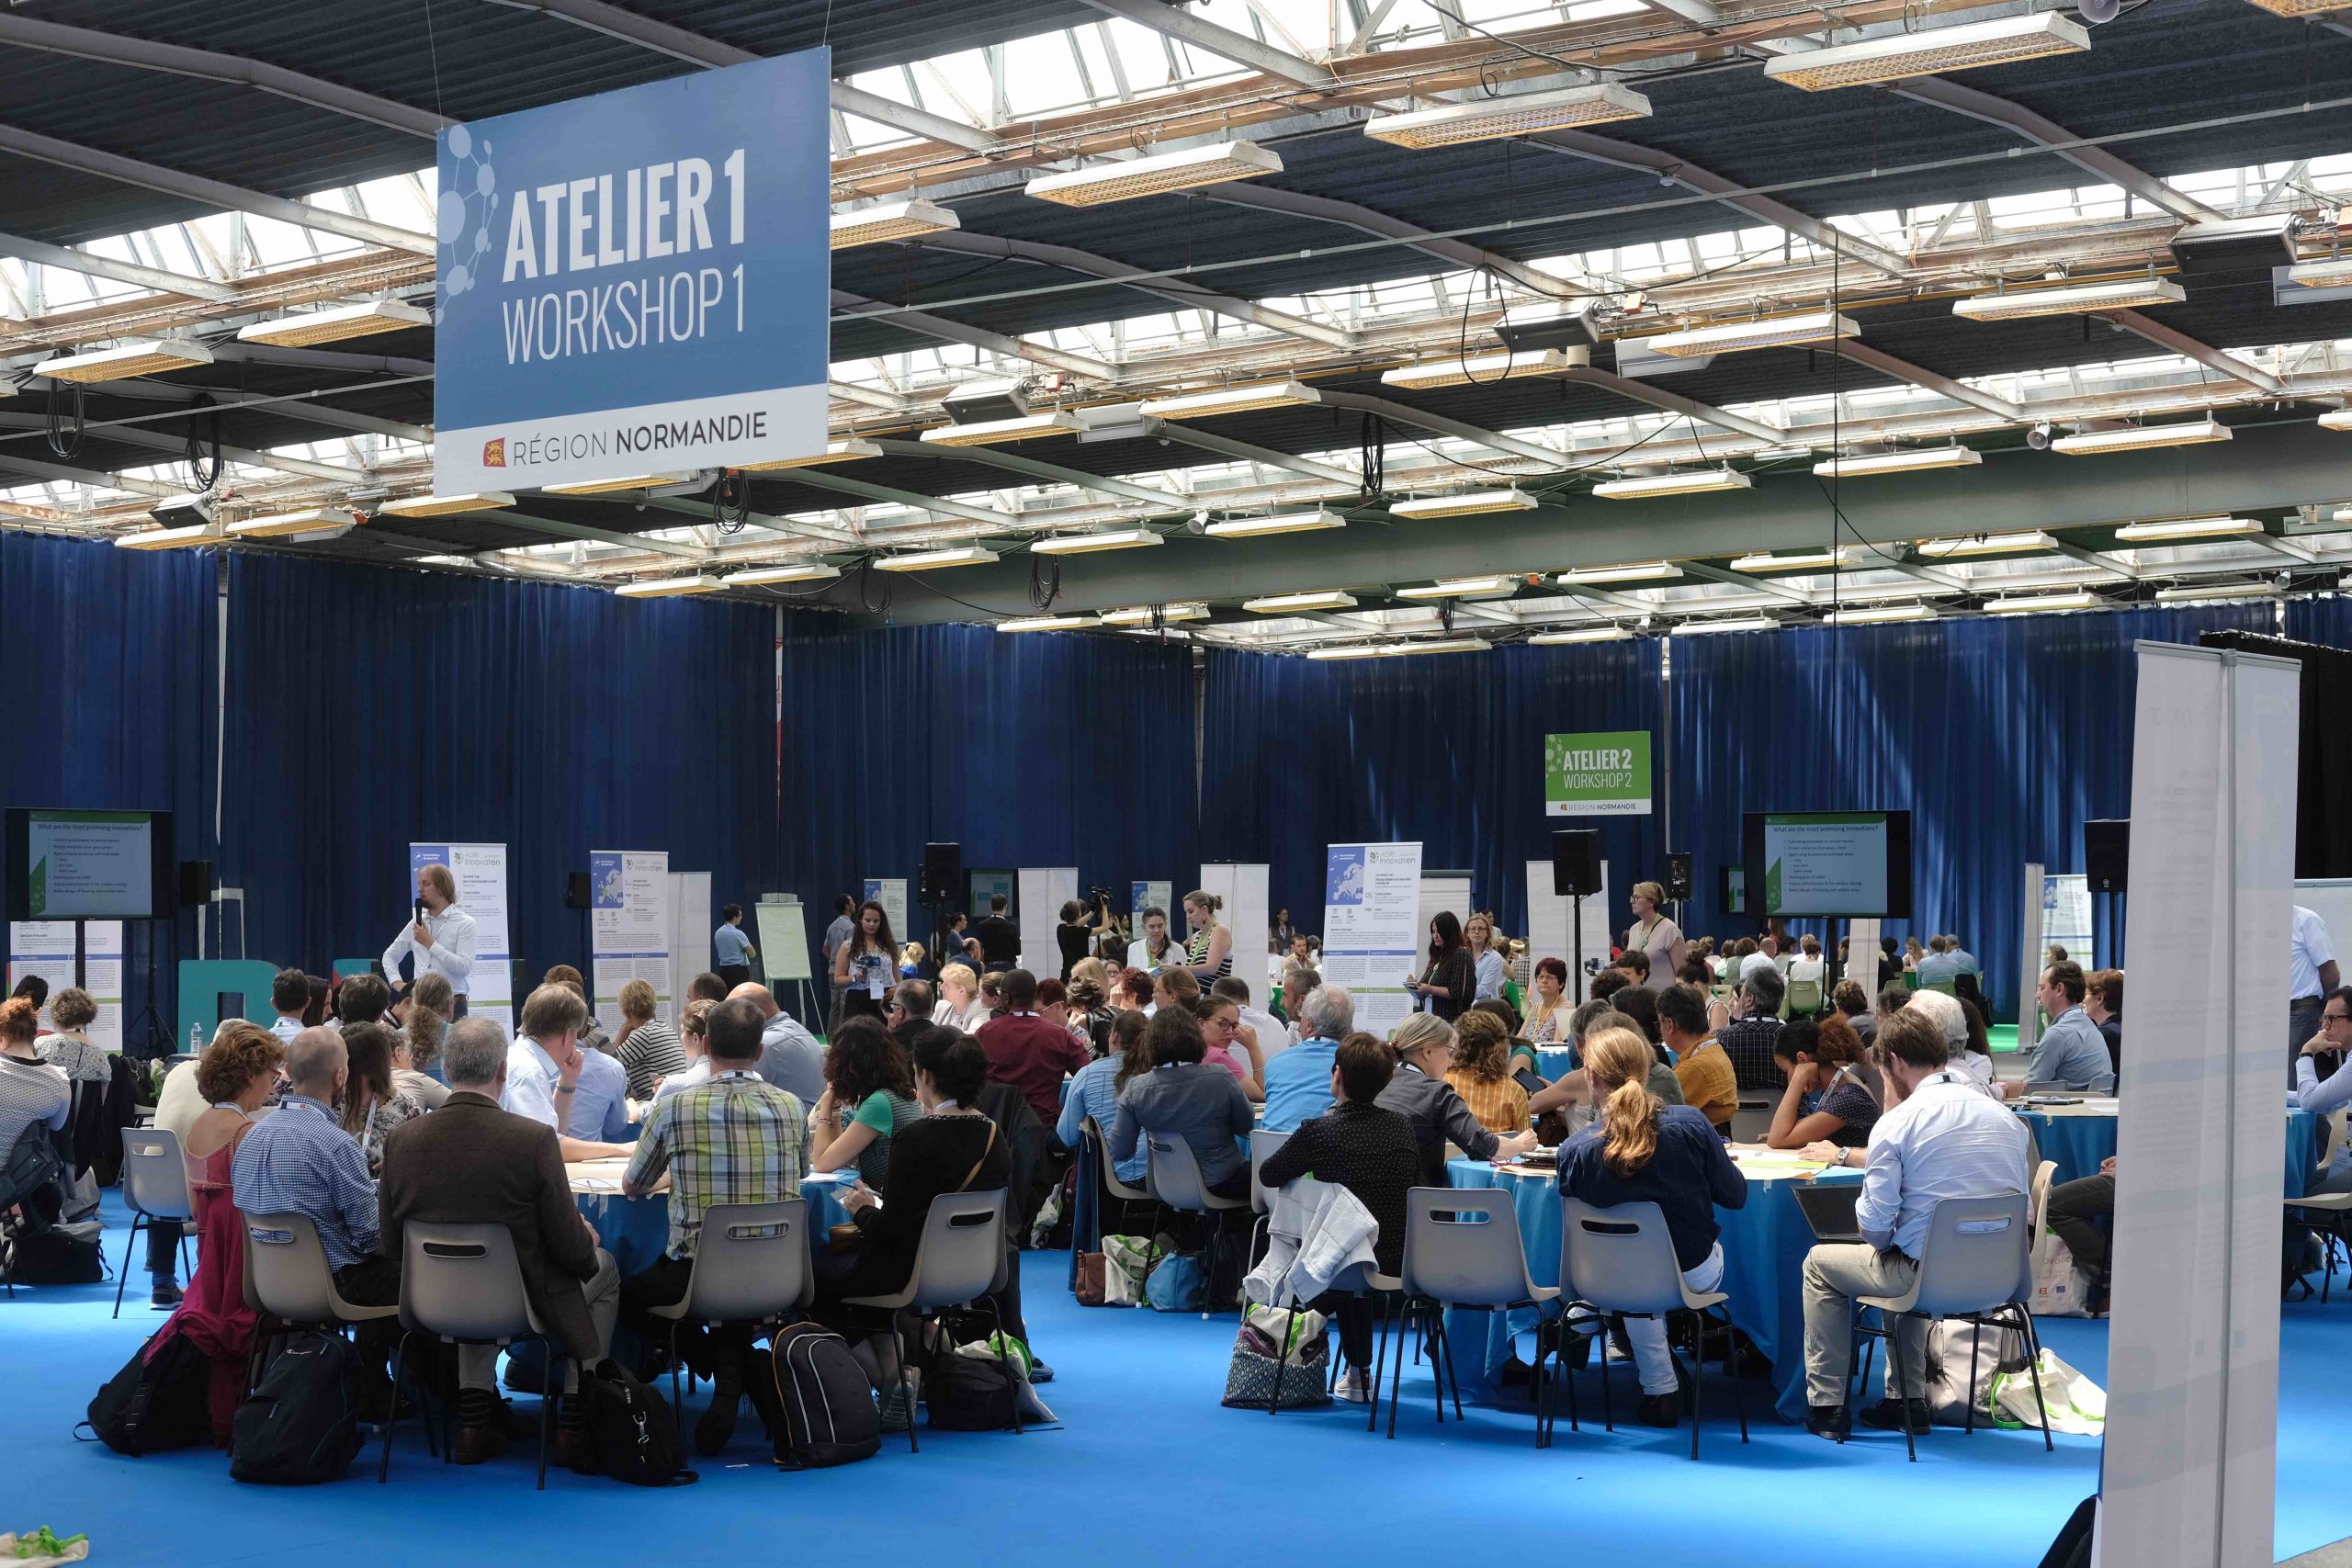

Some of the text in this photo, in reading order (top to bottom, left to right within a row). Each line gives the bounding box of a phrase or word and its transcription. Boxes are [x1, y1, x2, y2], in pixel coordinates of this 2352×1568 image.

[502, 148, 745, 283] ATELIER 1
[502, 263, 744, 365] WORKSHOP 1
[513, 411, 767, 467] RÉGION NORMANDIE
[1563, 749, 1633, 771] ATELIER 2
[1564, 772, 1633, 789] WORKSHOP 2
